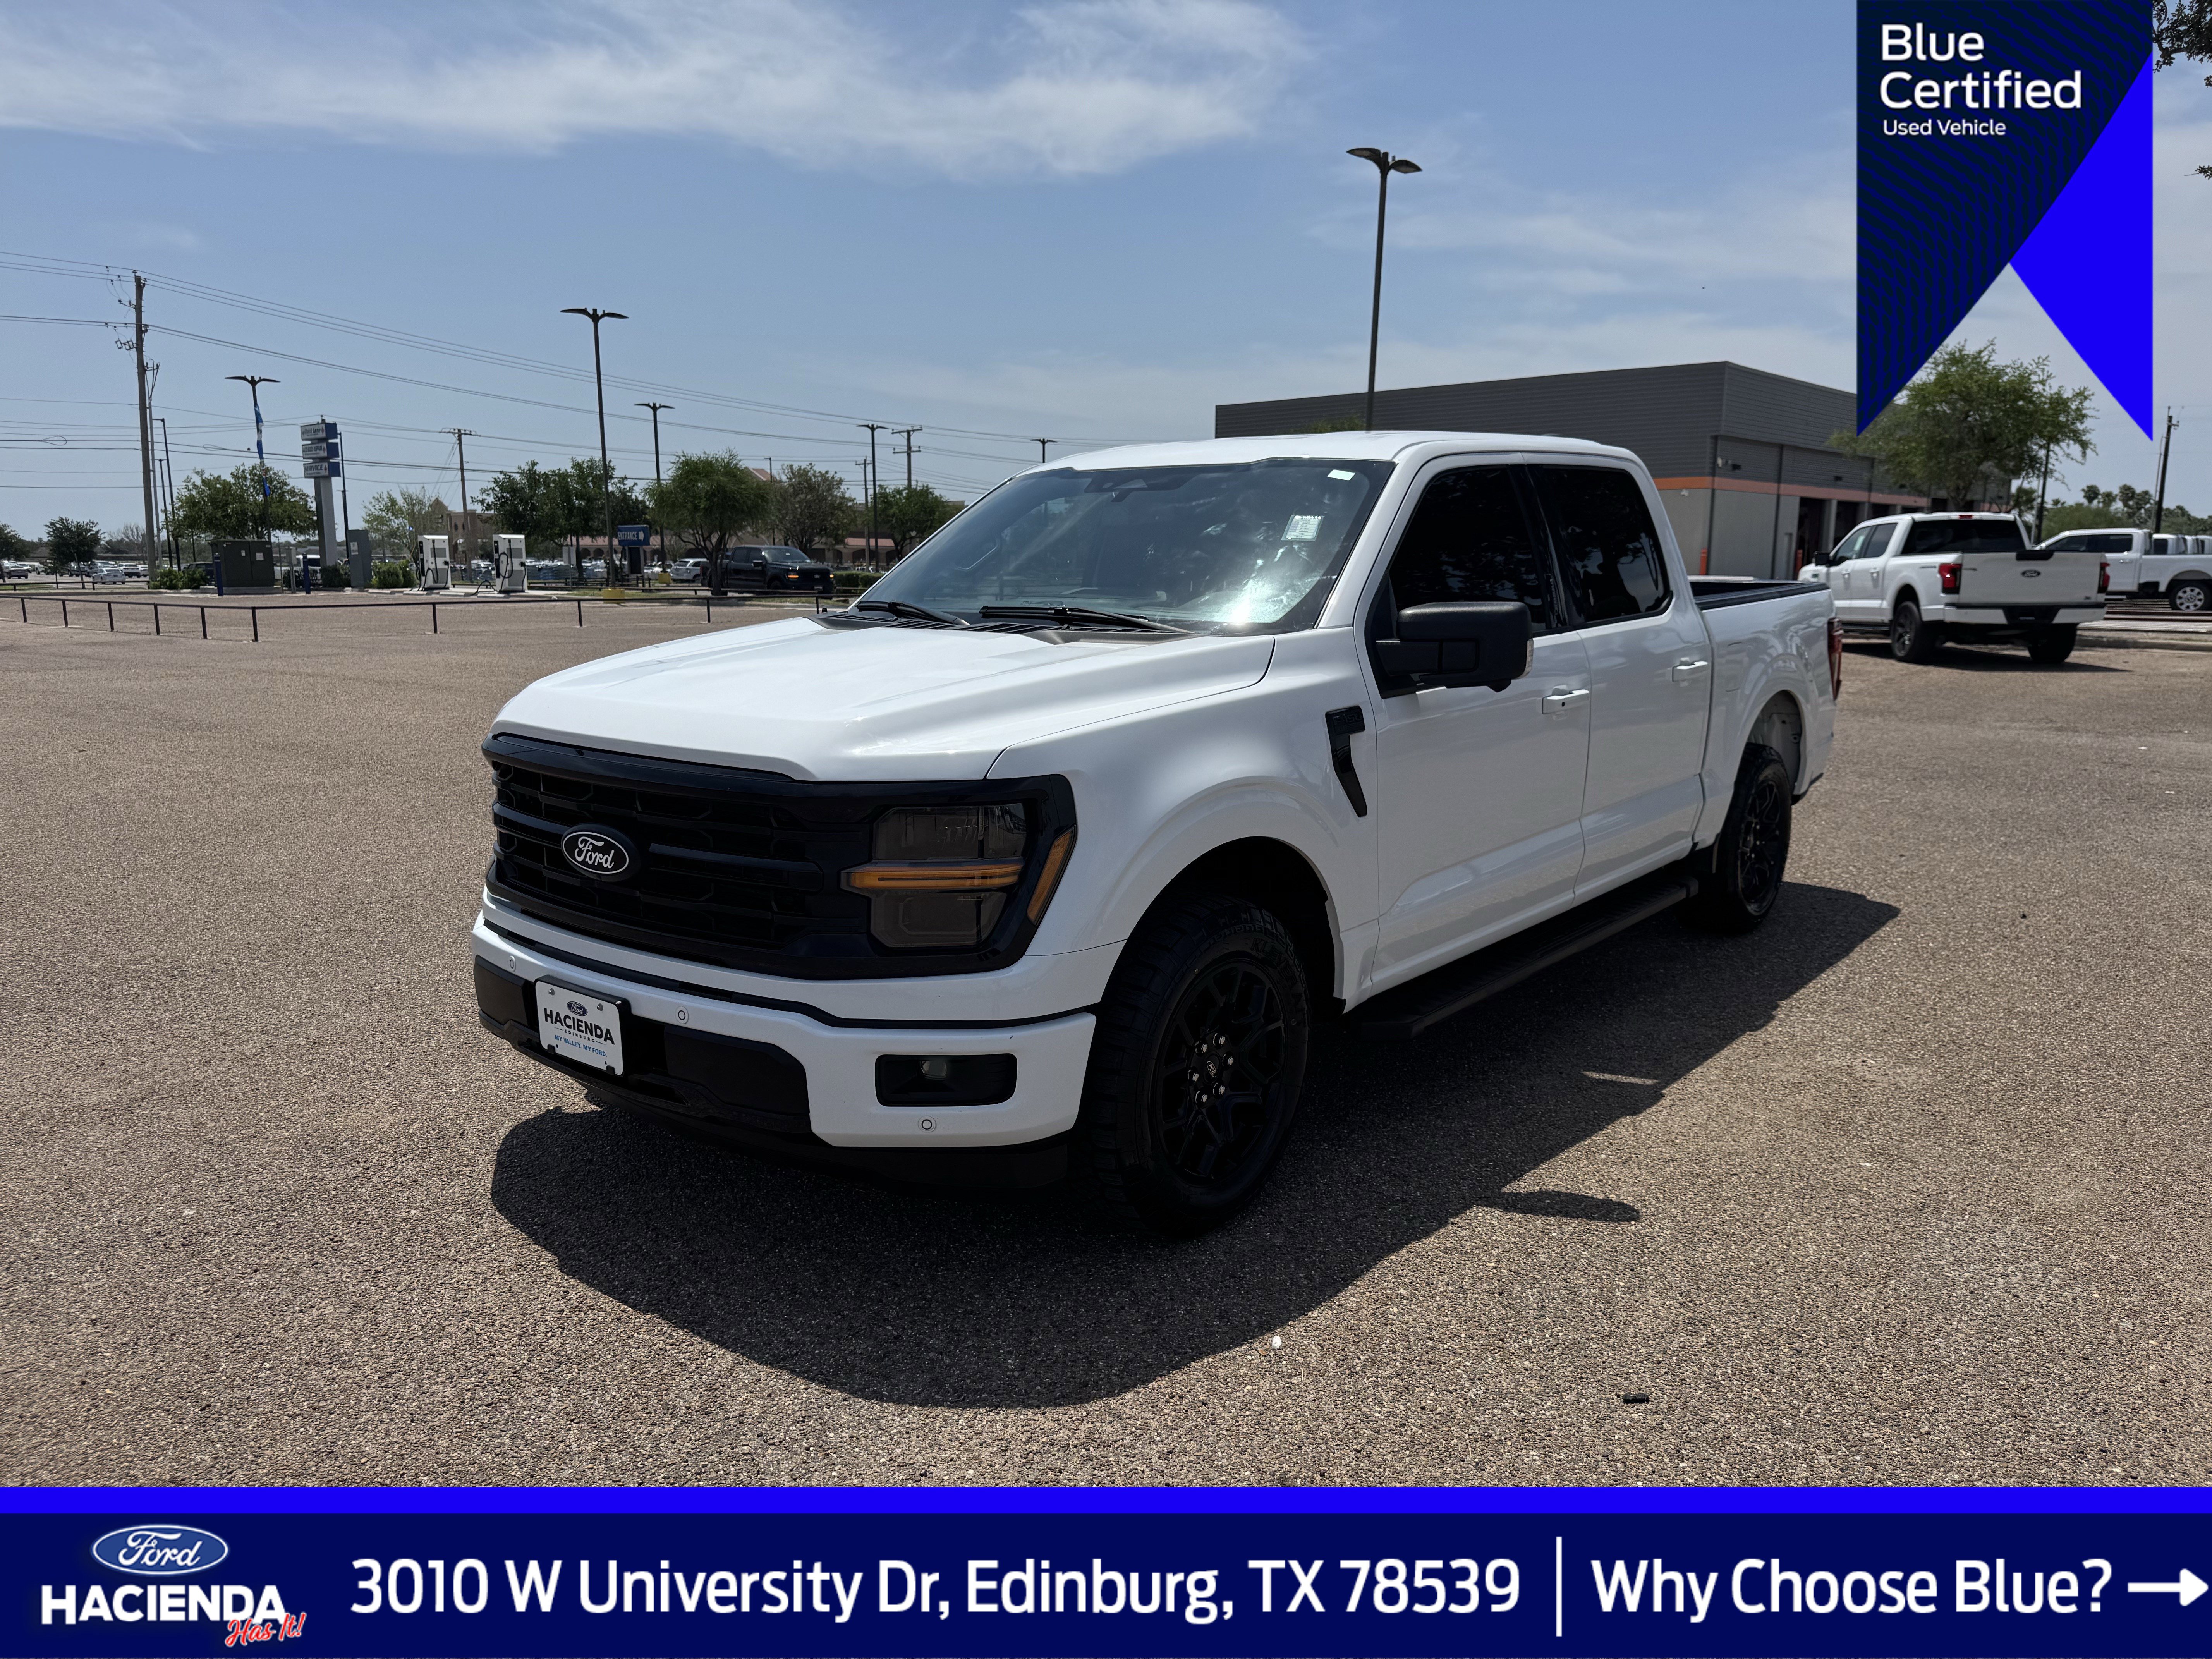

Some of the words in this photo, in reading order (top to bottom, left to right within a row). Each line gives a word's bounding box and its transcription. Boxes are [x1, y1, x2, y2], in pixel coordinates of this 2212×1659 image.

[618, 532, 638, 540] ENTRANCE
[575, 836, 615, 869] Ford
[570, 1003, 583, 1015] Ford
[544, 1007, 615, 1045] HACIENDA
[565, 1029, 595, 1043] EDINBURG
[592, 1048, 607, 1057] FORD.
[1208, 1063, 1216, 1075] Ford
